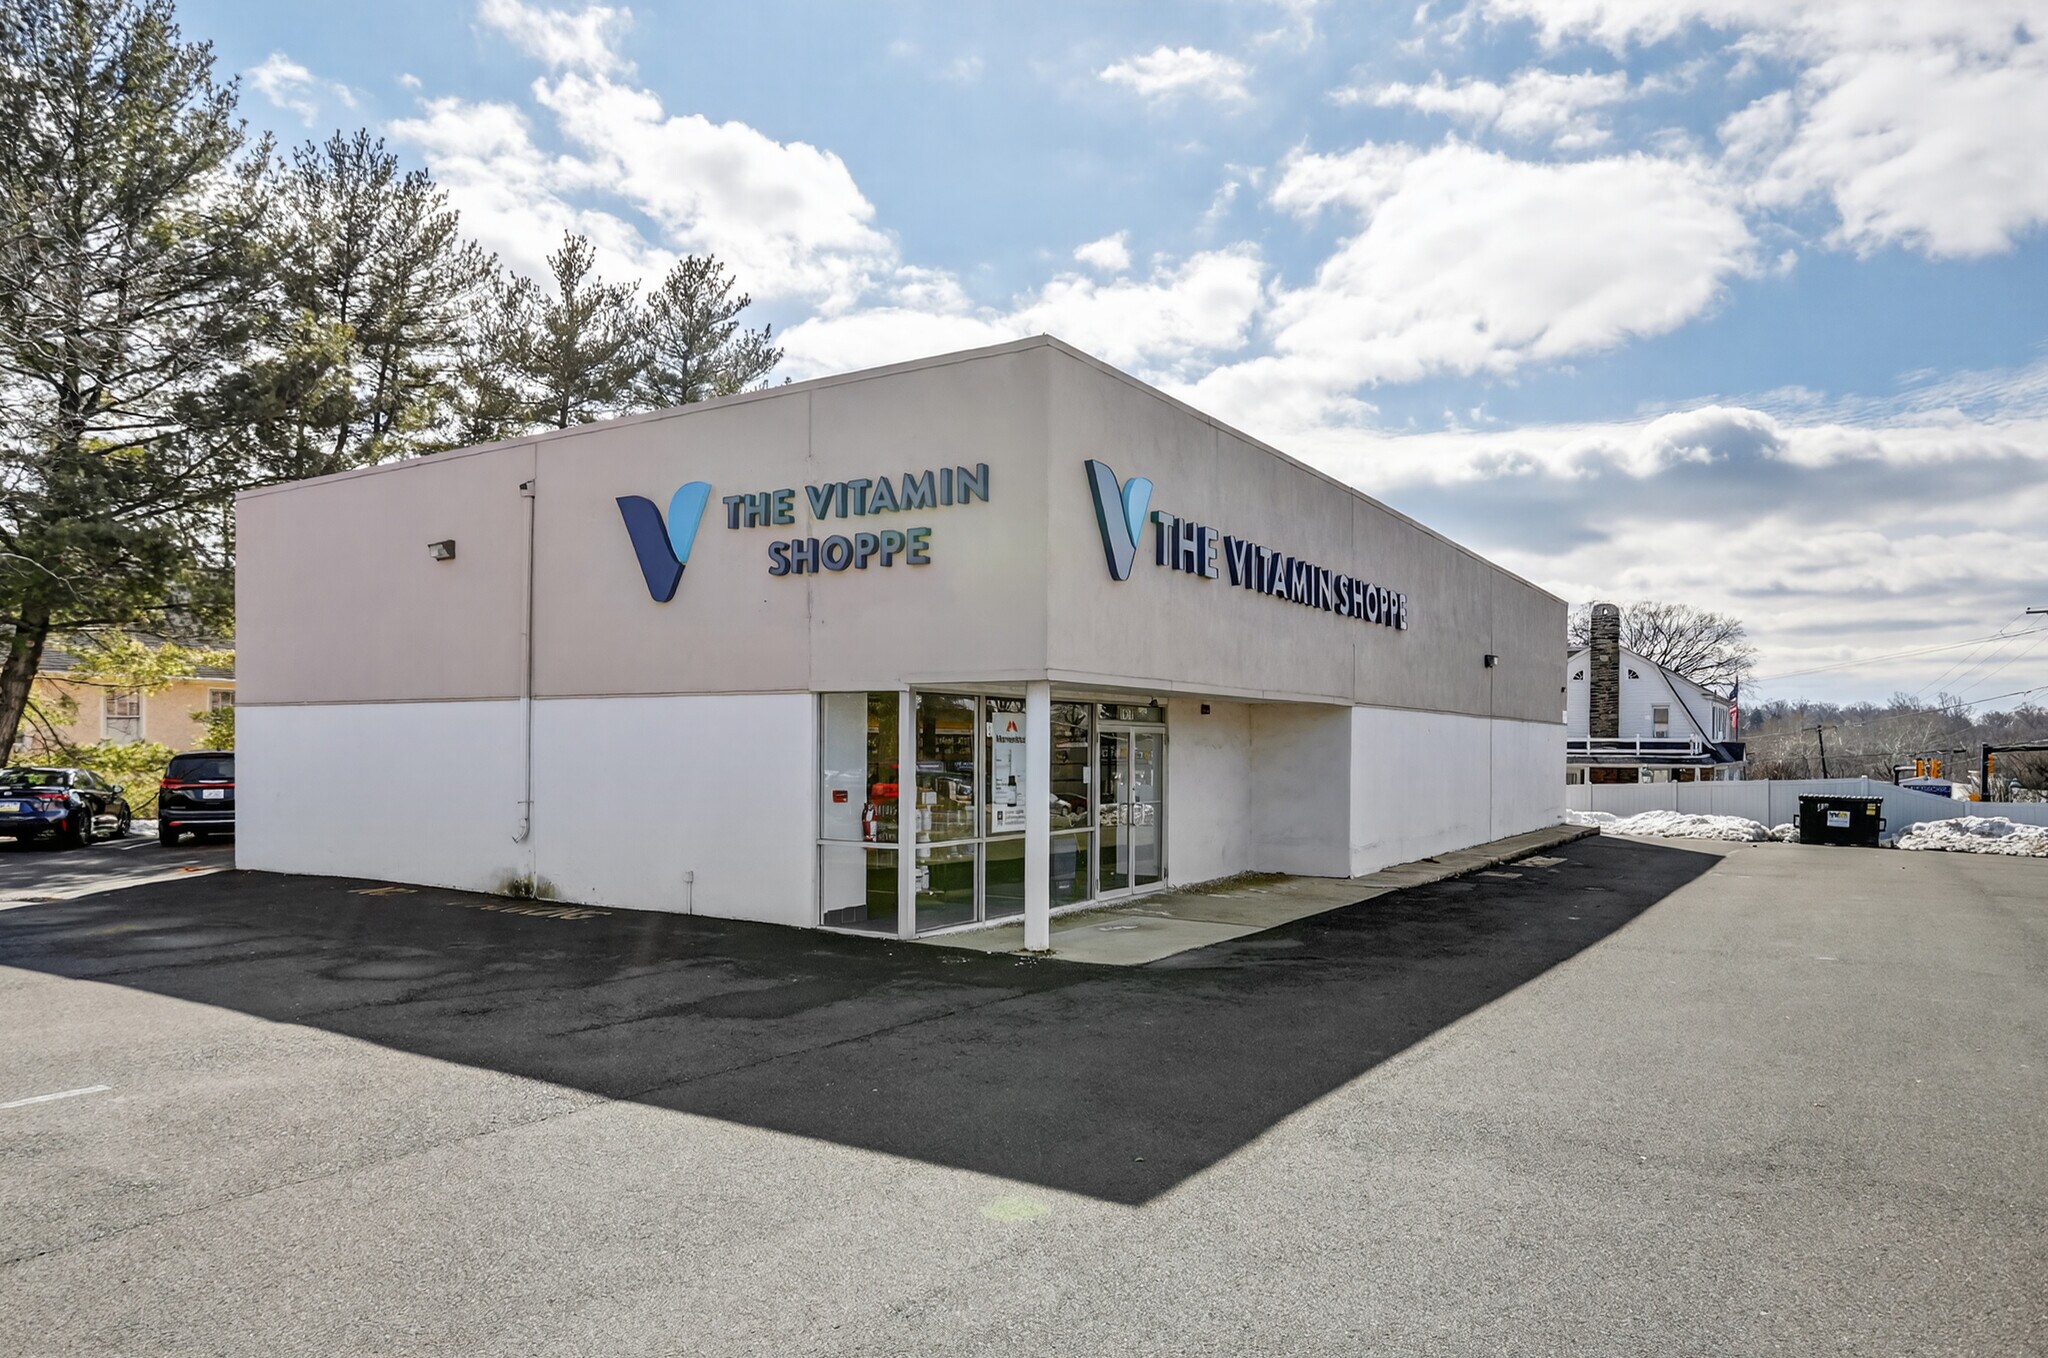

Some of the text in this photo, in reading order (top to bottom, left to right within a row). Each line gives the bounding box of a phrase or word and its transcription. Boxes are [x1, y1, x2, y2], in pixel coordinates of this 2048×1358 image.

[723, 463, 989, 529] THE VITAMIN
[768, 528, 931, 576] SHOPPE
[1150, 510, 1407, 630] THE VITAMIN SHOPPE
